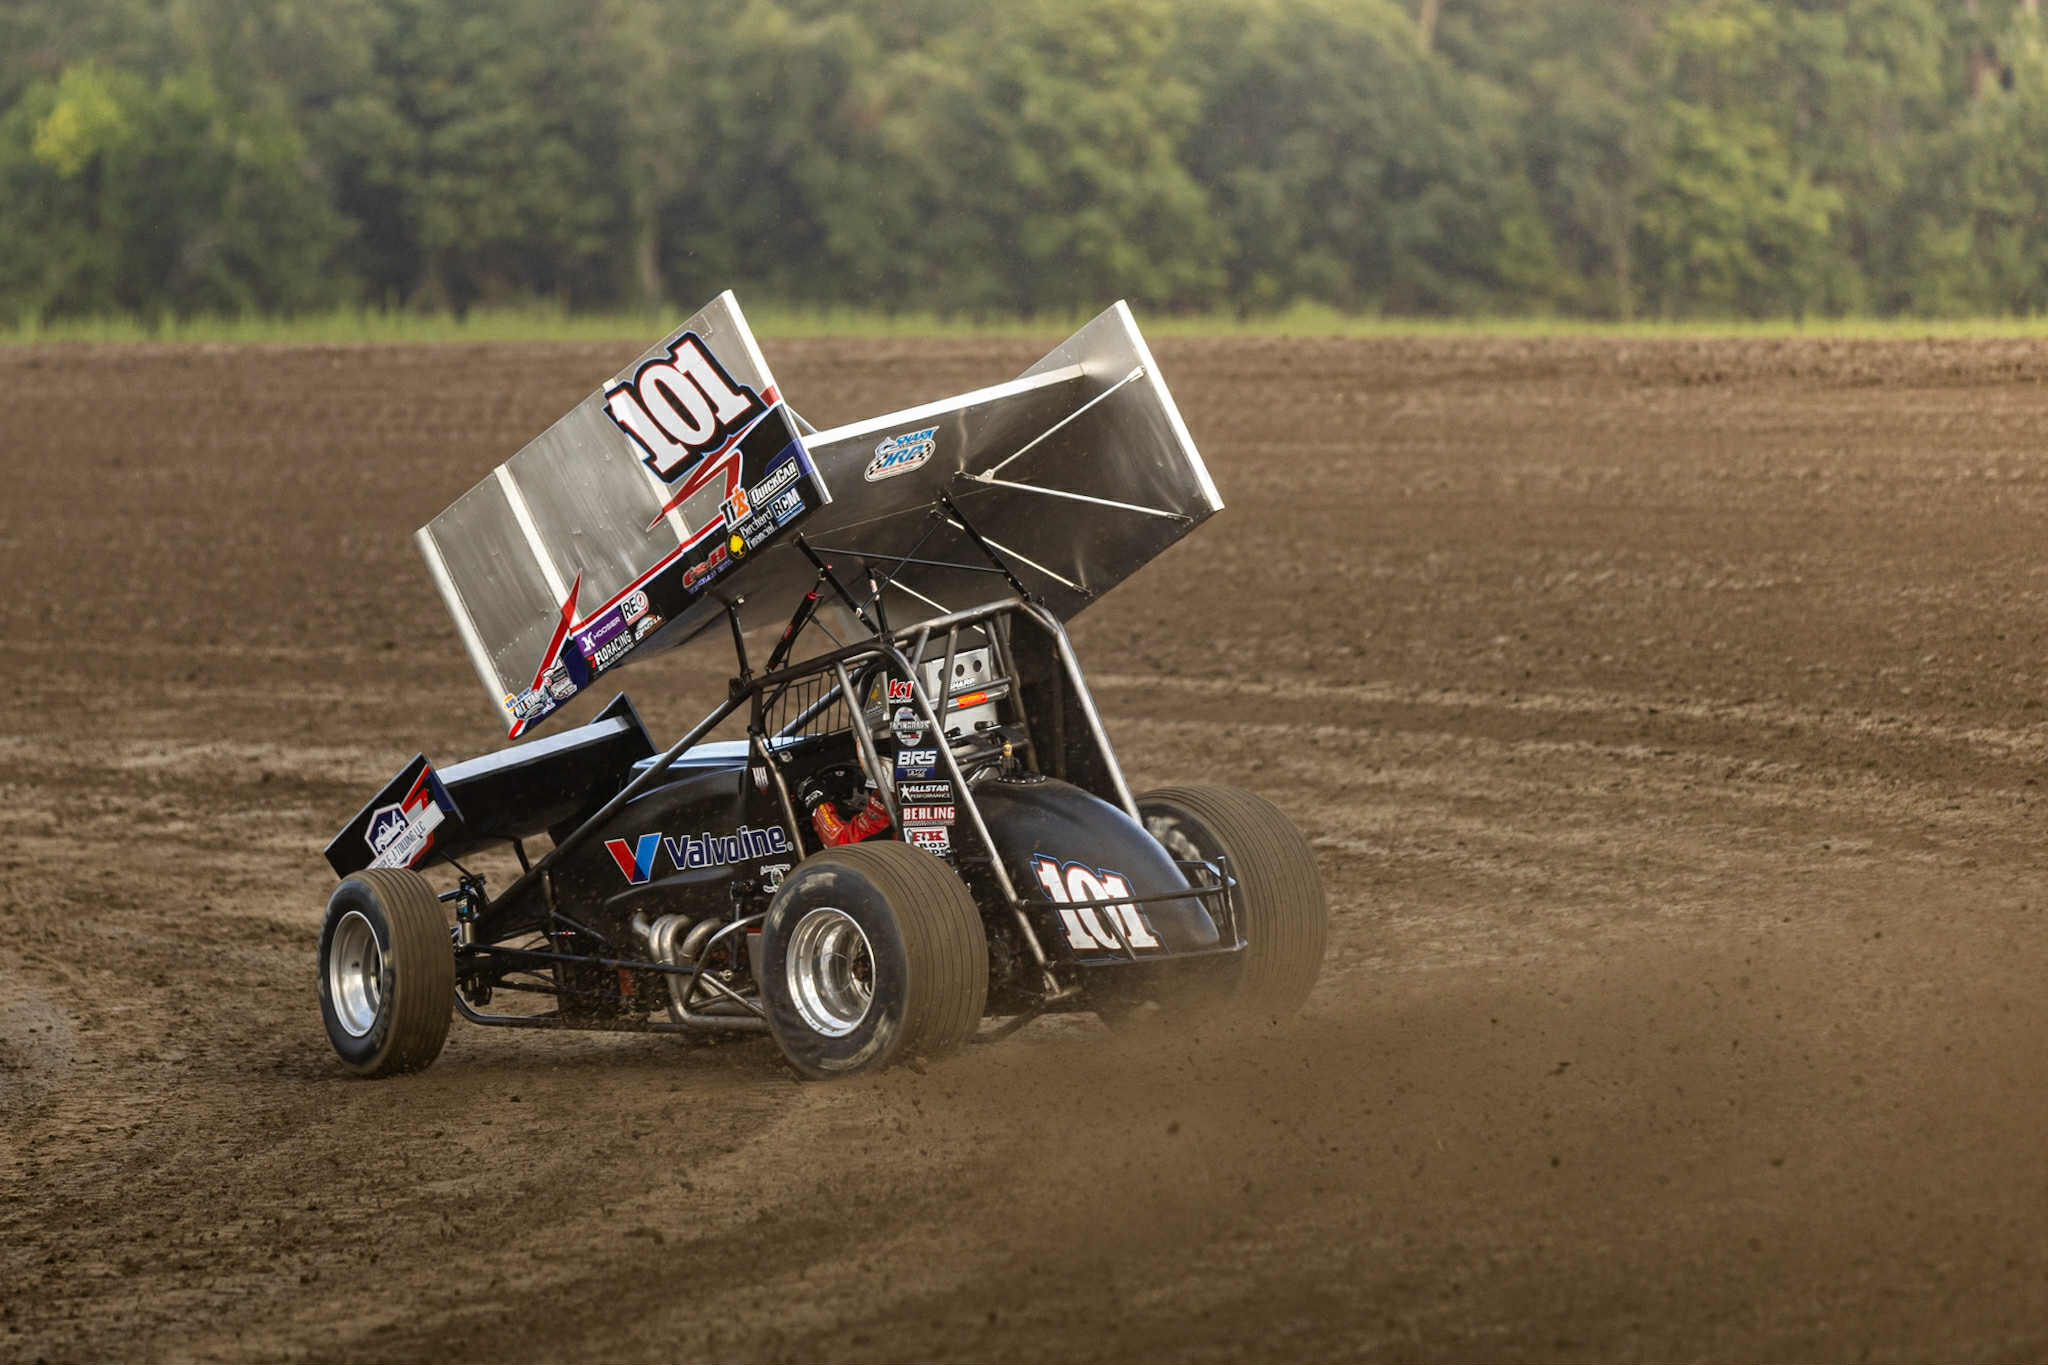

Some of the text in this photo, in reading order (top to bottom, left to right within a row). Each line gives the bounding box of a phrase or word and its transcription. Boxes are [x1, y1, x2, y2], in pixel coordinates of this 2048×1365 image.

[605, 335, 760, 479] 101
[771, 487, 801, 519] RCM
[740, 506, 774, 539] Birchard
[592, 616, 621, 639] HOOSIER
[897, 750, 938, 766] BRS
[909, 784, 949, 793] ALLSTAR
[903, 806, 955, 820] BEHLING
[663, 825, 788, 870] Valvoline
[1034, 857, 1163, 955] 101
